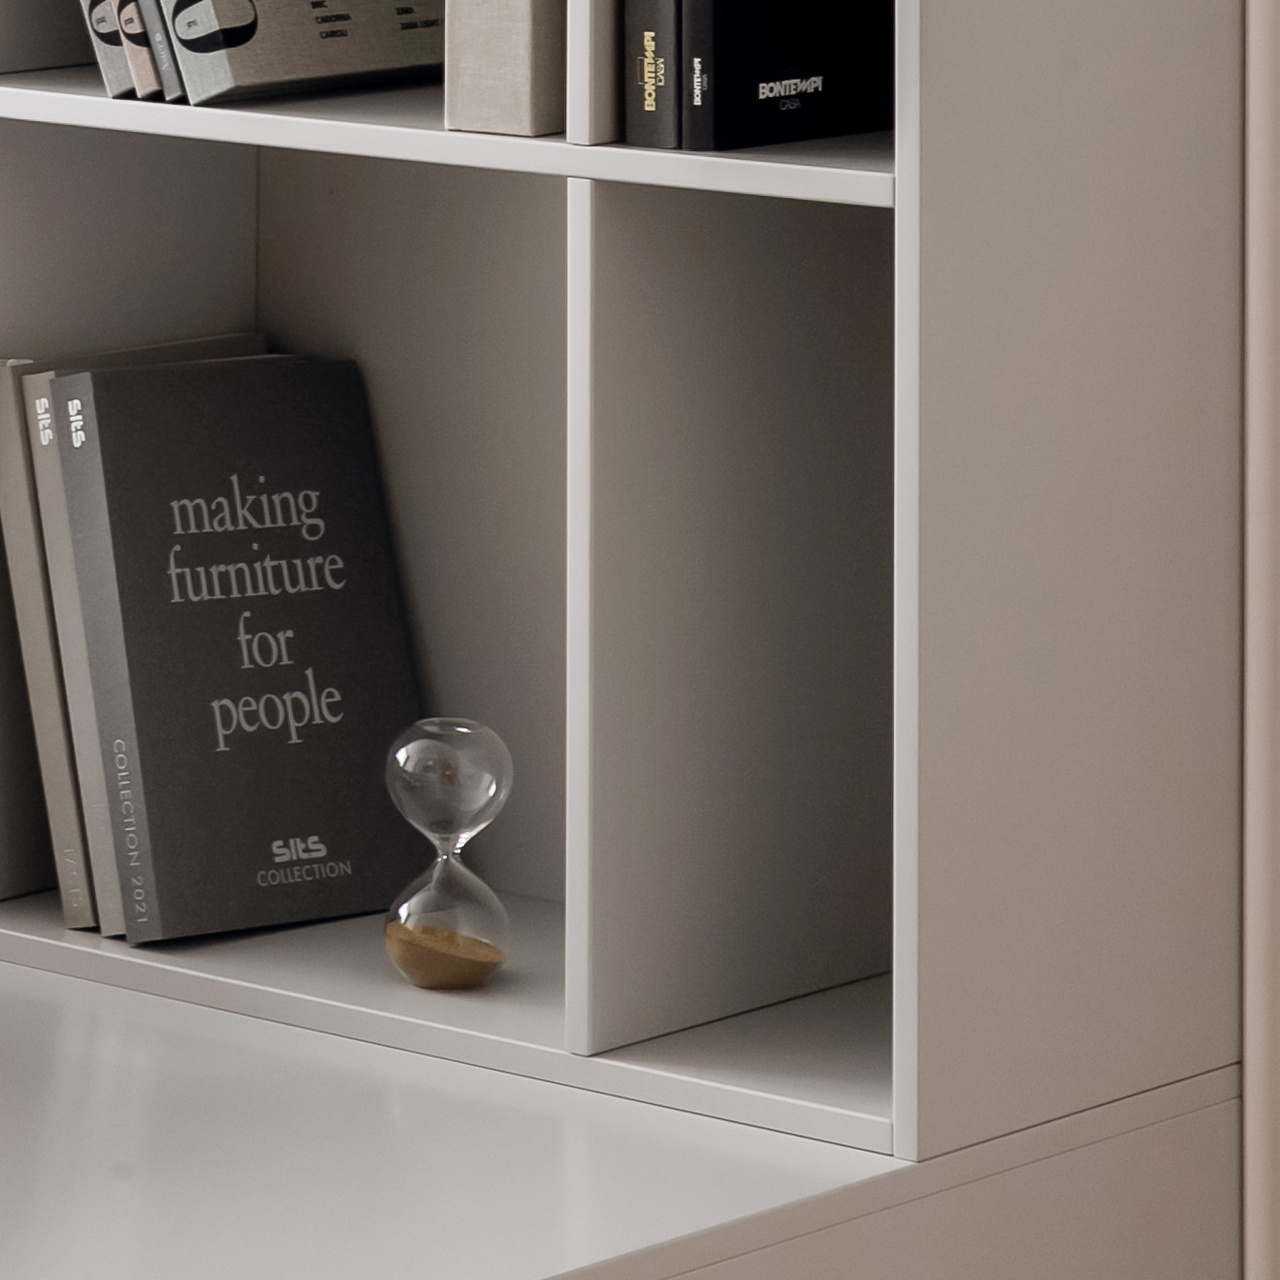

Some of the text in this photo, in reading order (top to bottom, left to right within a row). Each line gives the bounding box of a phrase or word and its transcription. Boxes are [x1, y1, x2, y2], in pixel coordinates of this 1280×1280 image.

[169, 474, 326, 542] making
[166, 543, 346, 604] furniture
[236, 612, 294, 670] for
[211, 669, 344, 753] people
[112, 738, 149, 923] COLLECTION 2021
[256, 860, 353, 887] COLLECTION
